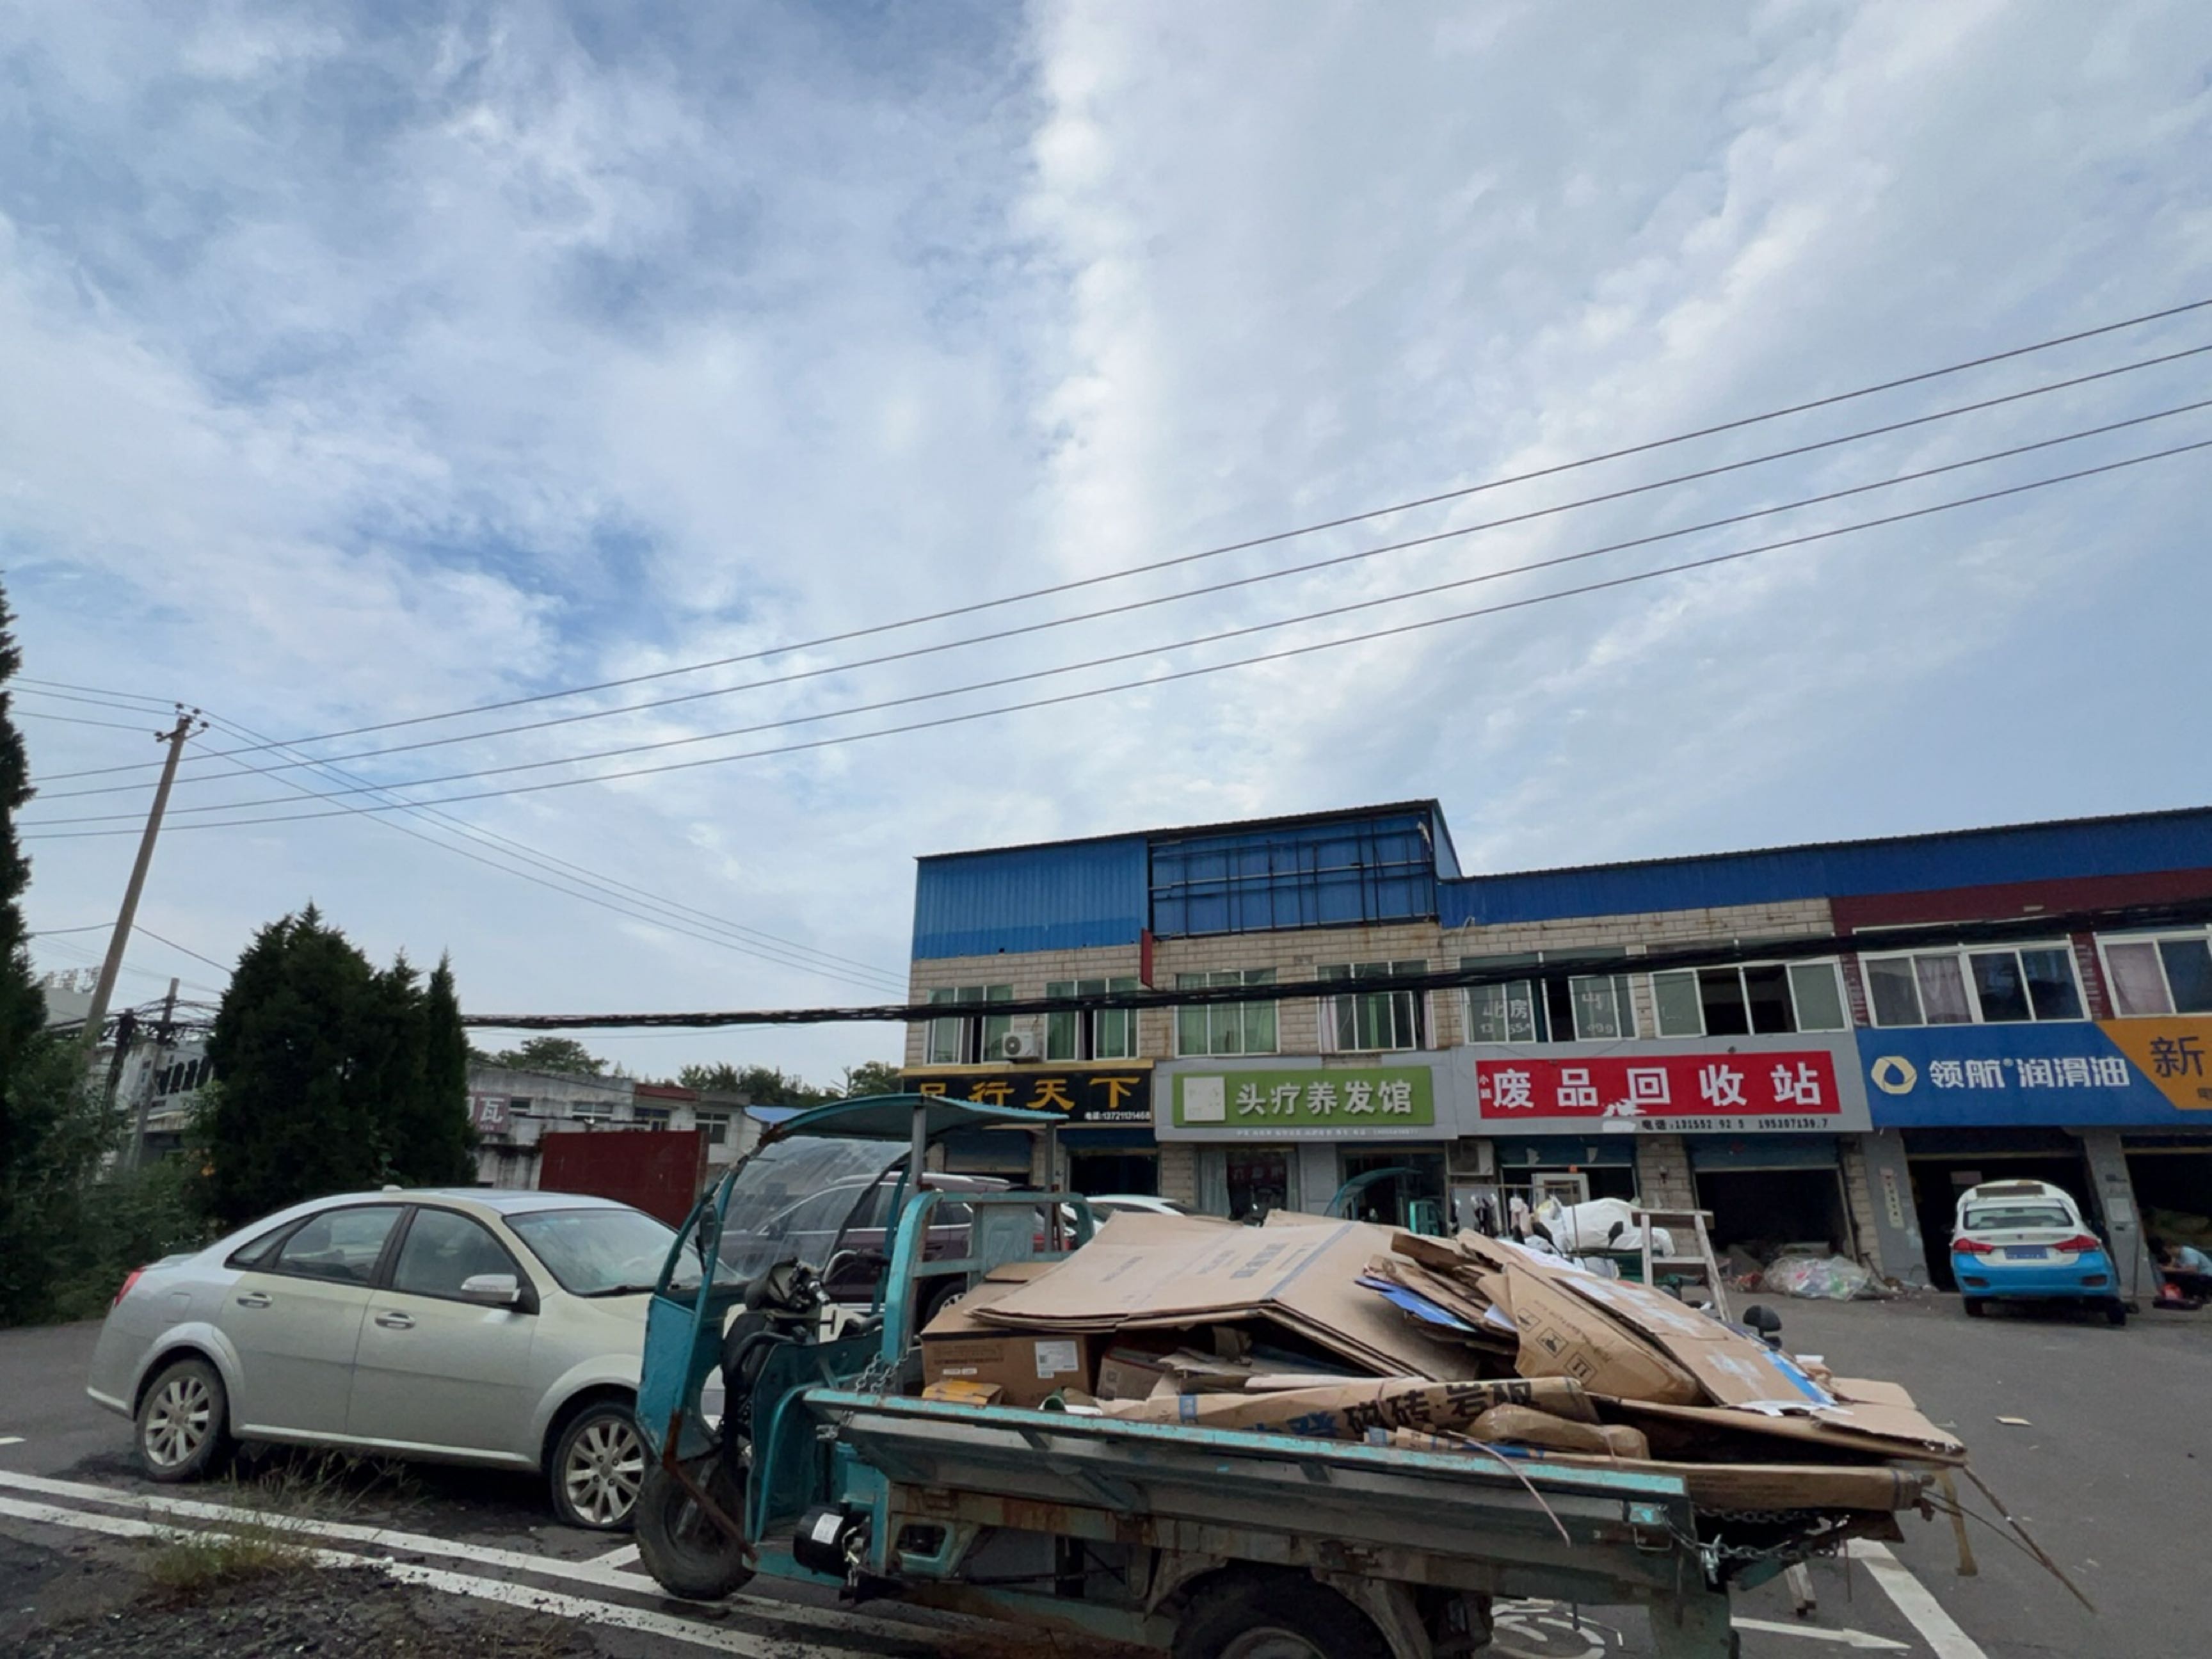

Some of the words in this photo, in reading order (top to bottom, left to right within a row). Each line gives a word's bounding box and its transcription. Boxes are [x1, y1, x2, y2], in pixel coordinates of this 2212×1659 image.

[2150, 1037, 2206, 1077] 新
[1236, 1080, 1412, 1116] 头疗养发馆
[1493, 1062, 1822, 1109] 废品回收站
